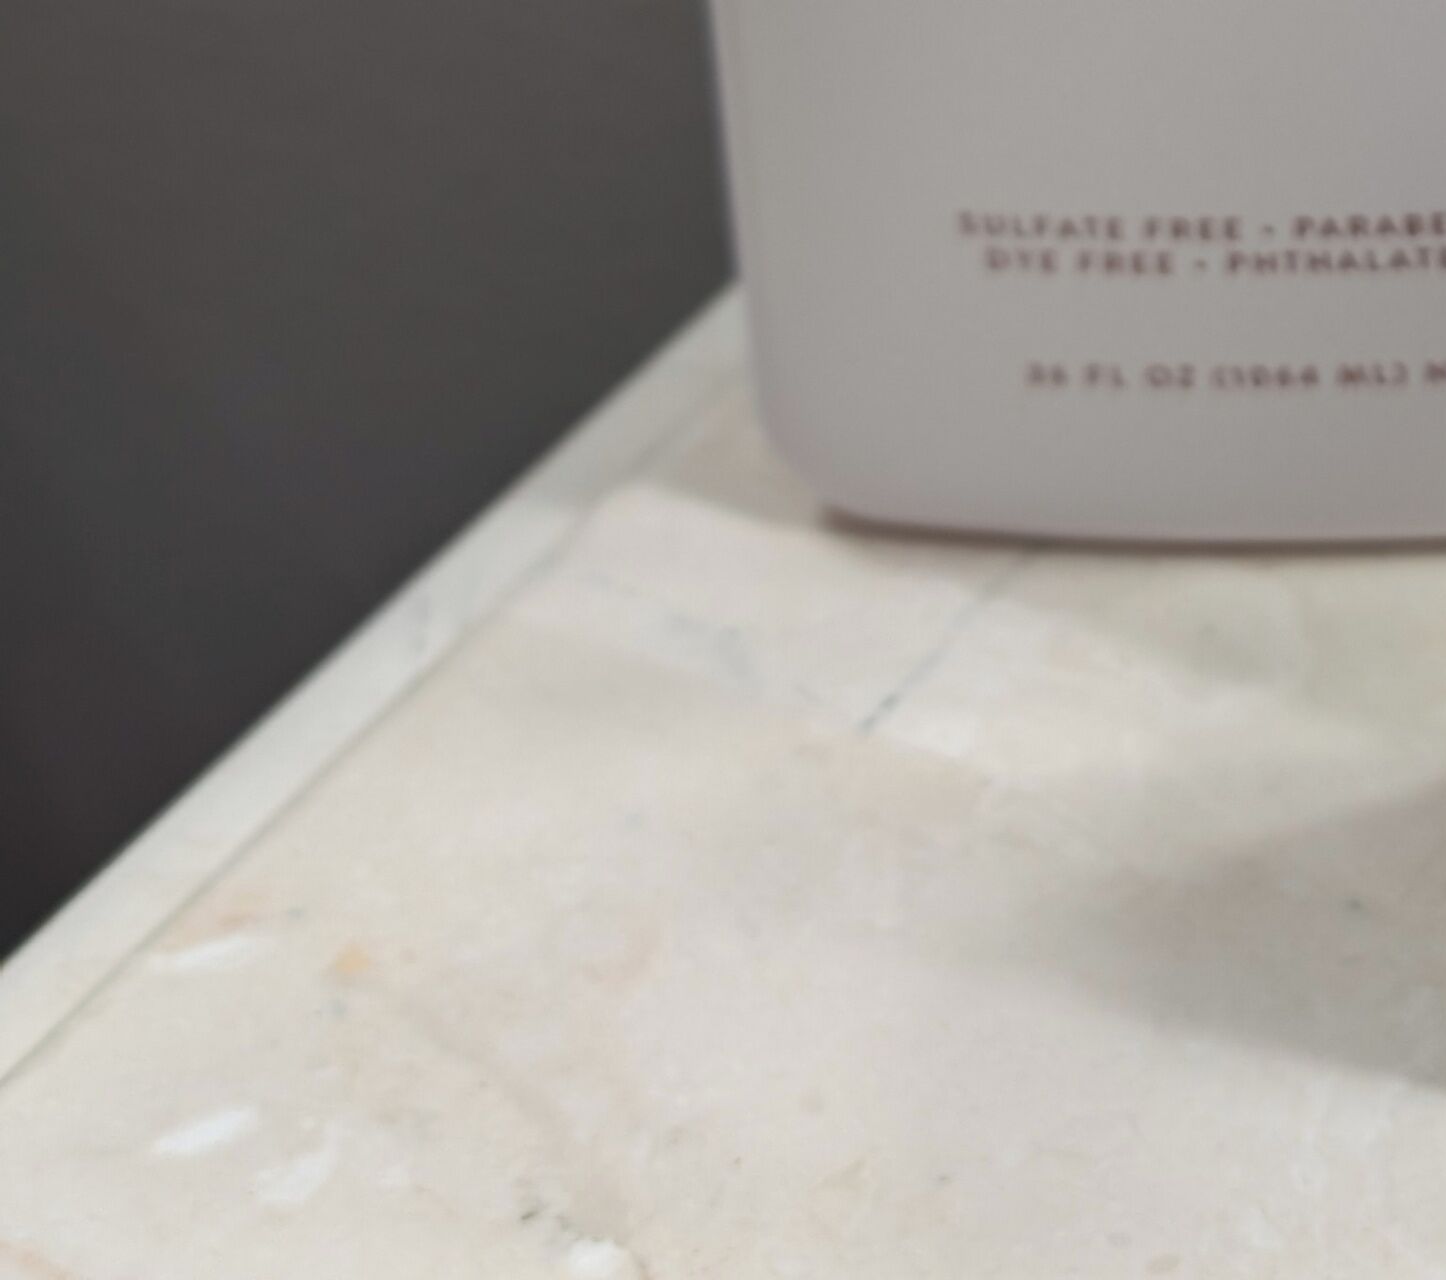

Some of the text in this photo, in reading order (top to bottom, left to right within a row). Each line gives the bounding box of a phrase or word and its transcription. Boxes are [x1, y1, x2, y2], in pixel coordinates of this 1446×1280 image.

[958, 210, 1124, 240] SULFATE
[1143, 215, 1241, 242] FREE
[985, 247, 1057, 275] DYE
[1077, 250, 1172, 276] FREE
